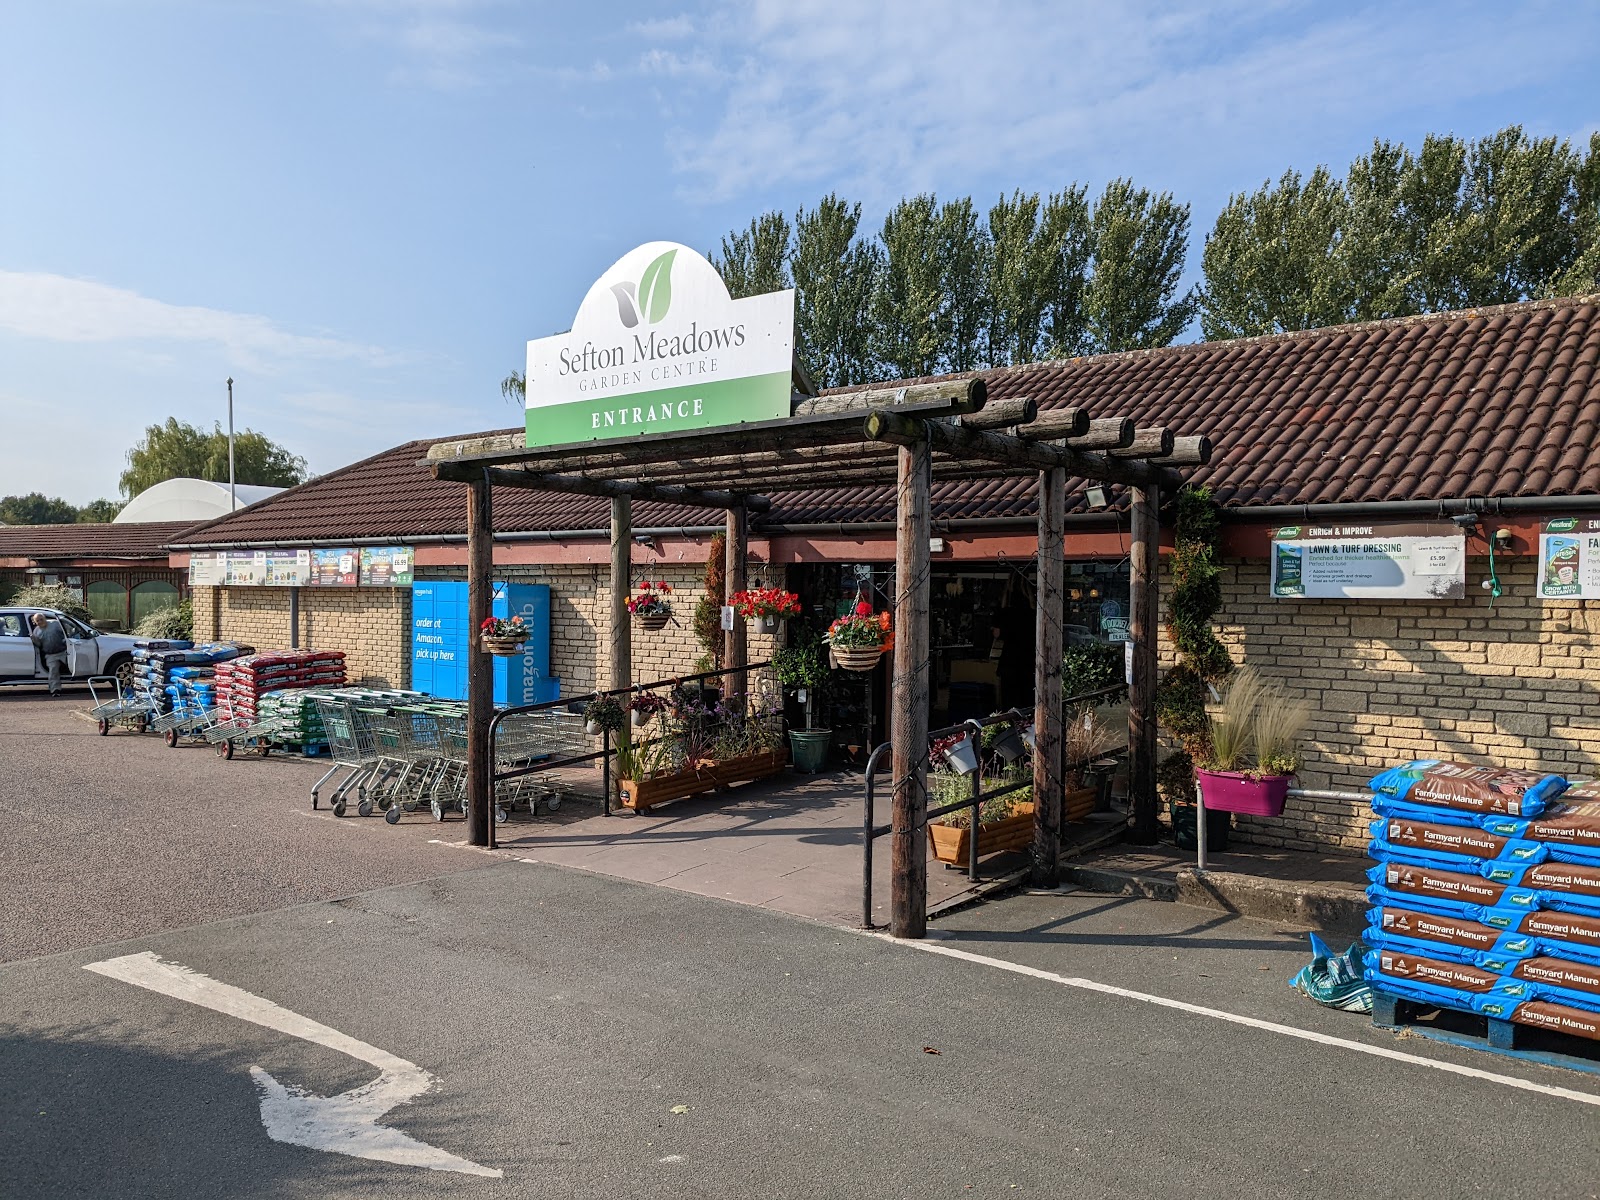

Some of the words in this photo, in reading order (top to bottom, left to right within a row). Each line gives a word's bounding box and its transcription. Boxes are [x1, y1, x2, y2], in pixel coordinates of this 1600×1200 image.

[559, 341, 624, 376] Sefton
[632, 321, 746, 364] Meadows
[579, 370, 642, 393] GARDEN
[651, 357, 719, 381] CENTRE
[591, 398, 704, 429] ENTRANCE
[1309, 527, 1333, 536] ENRICH
[1334, 527, 1340, 536] &
[1342, 526, 1373, 536] IMPROVE
[1588, 520, 1600, 529] EN
[1309, 545, 1330, 554] LAWN
[1332, 545, 1339, 554] &
[1341, 544, 1361, 554] TURF
[1363, 543, 1402, 553] DRESSING
[1589, 538, 1600, 548] FA
[416, 617, 433, 628] order
[433, 618, 441, 629] at
[416, 633, 444, 646] Amazon,
[415, 648, 429, 660] pick
[430, 650, 438, 661] up
[439, 649, 455, 661] here
[523, 645, 535, 707] mazon
[1415, 788, 1451, 801] Farmyard
[1452, 794, 1483, 806] Manure
[1424, 830, 1461, 844] Farmyard
[1463, 837, 1495, 849] Manure
[1534, 825, 1575, 837] Farmyard
[1422, 876, 1460, 891] Farmyard
[1461, 883, 1493, 896] Manure
[1531, 872, 1571, 885] Farmyard
[1418, 920, 1455, 936] Farmyard
[1456, 928, 1488, 942] Manure
[1528, 919, 1569, 934] Farmyard
[1416, 963, 1453, 979] Farmyard
[1454, 971, 1486, 986] Manure
[1523, 964, 1563, 980] Farmyard
[1564, 972, 1599, 986] Manure
[1521, 1008, 1560, 1025] Farmyard
[1562, 1017, 1596, 1032] Manure
